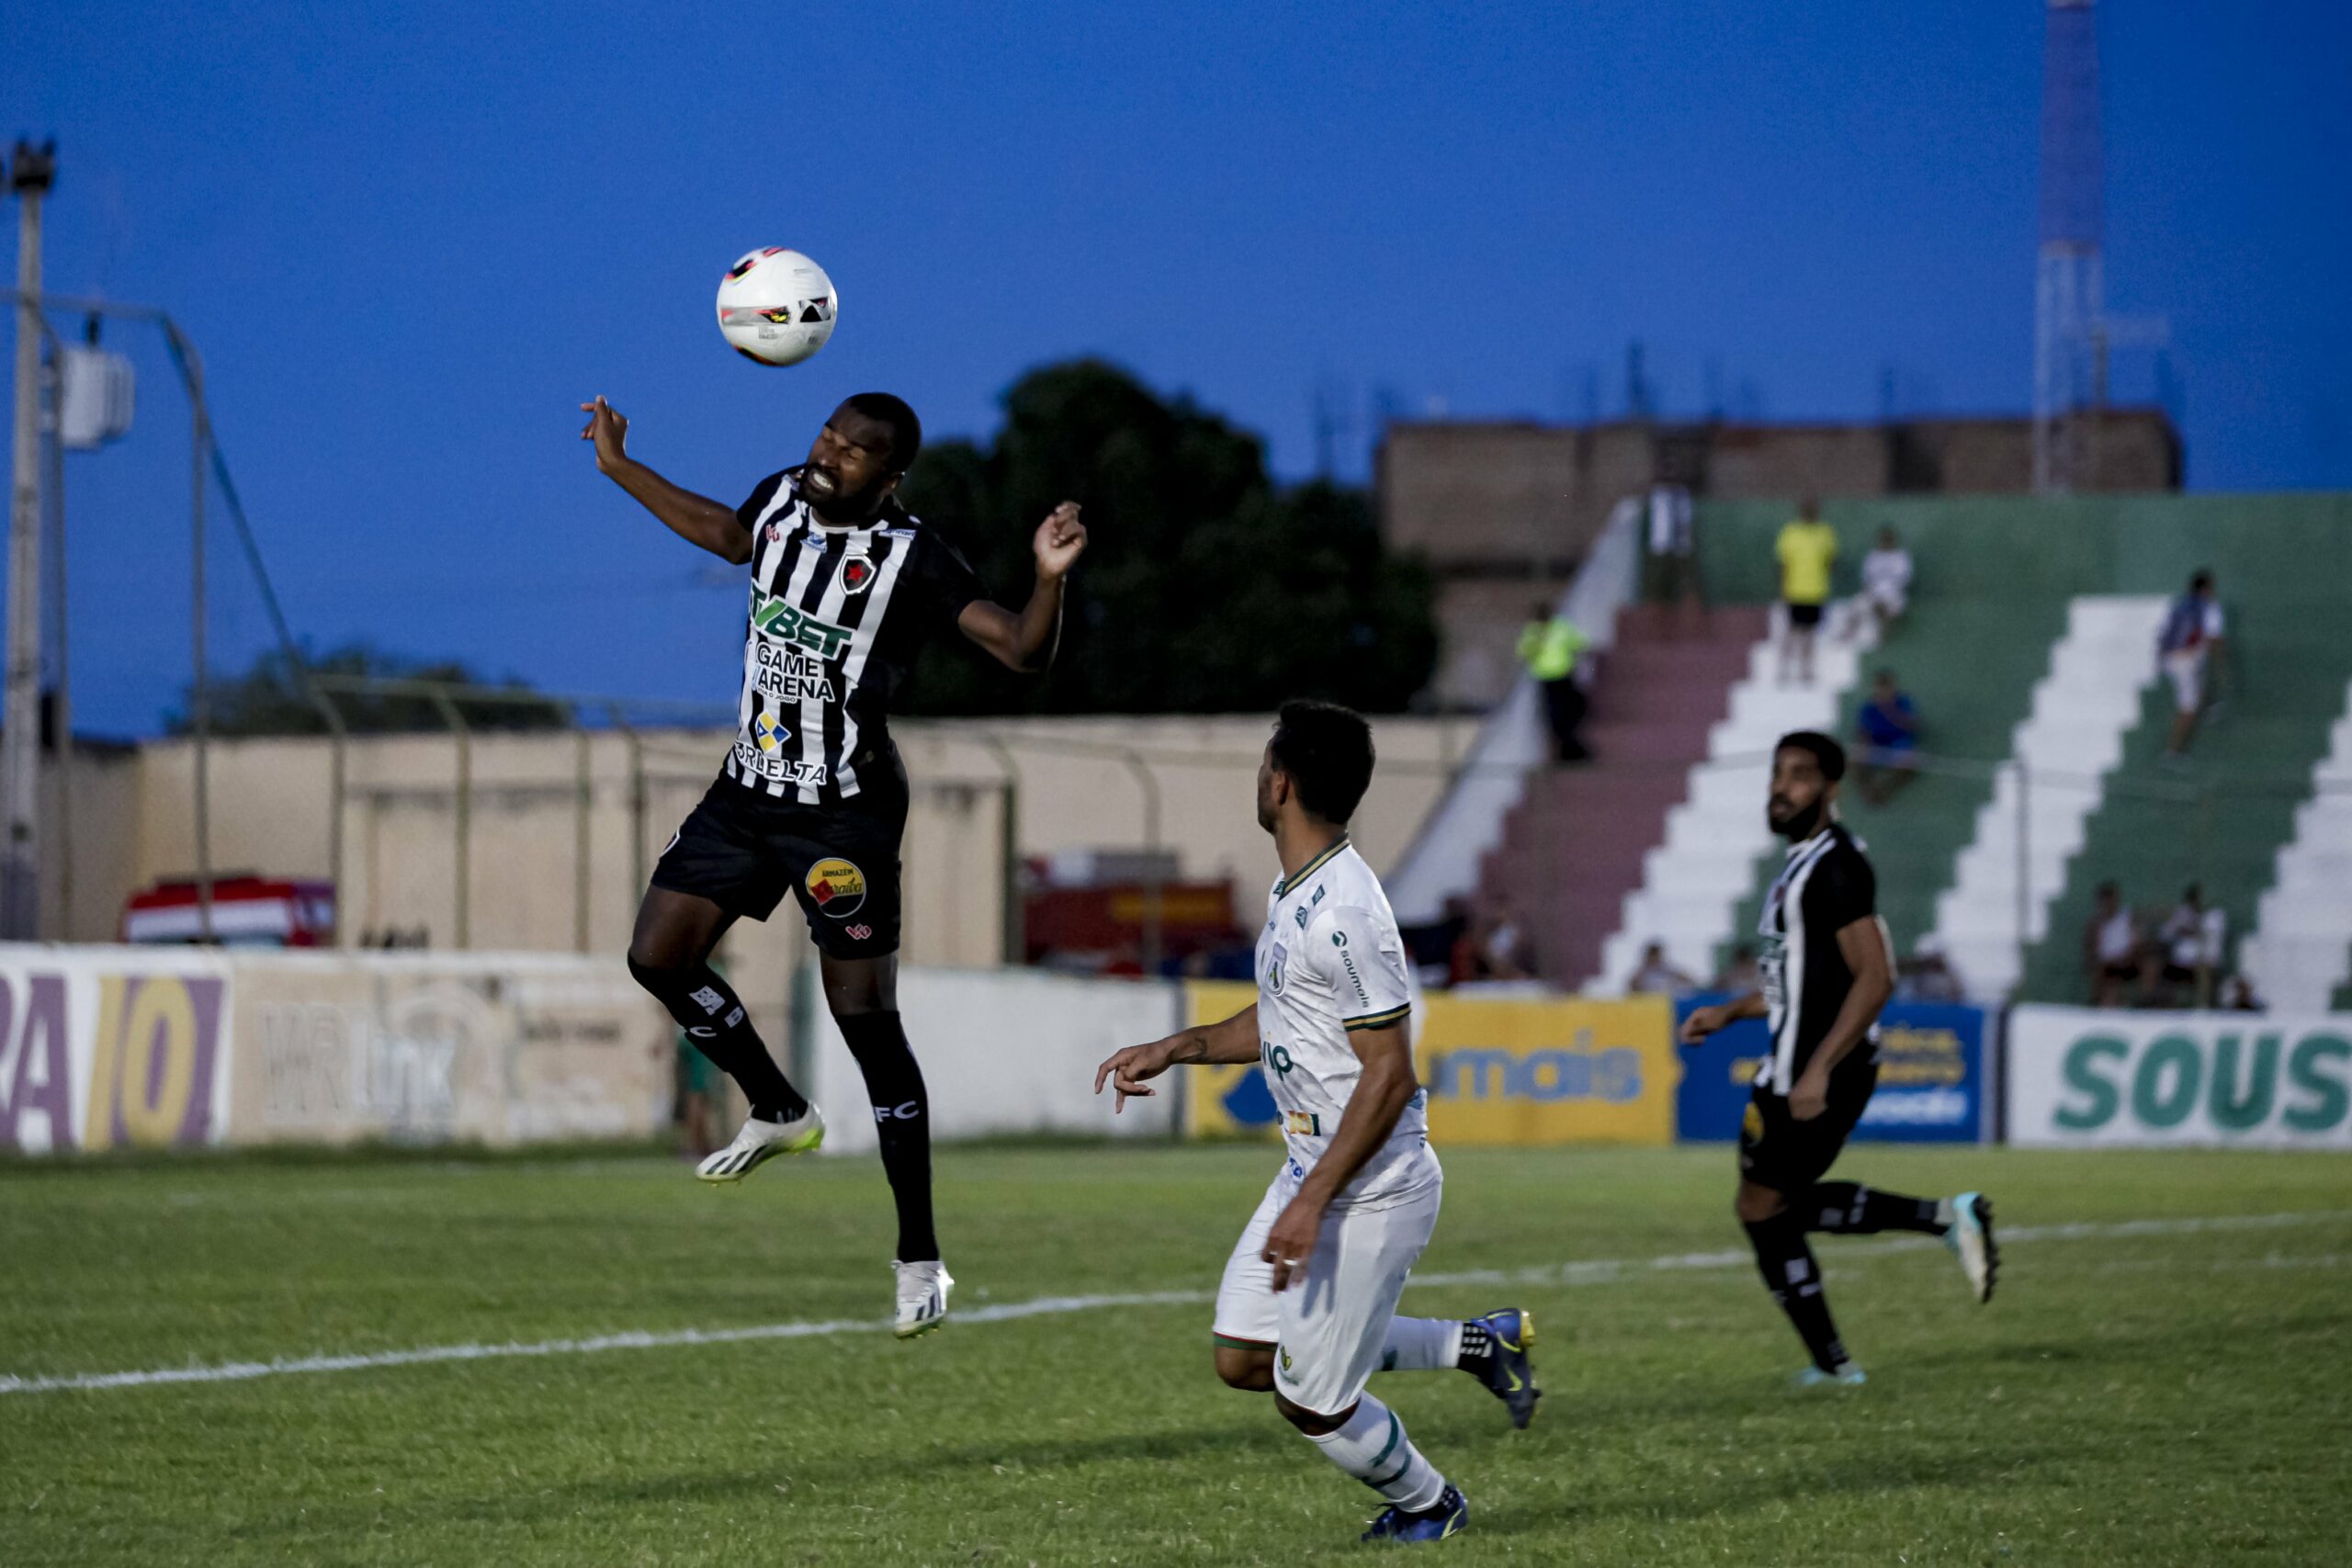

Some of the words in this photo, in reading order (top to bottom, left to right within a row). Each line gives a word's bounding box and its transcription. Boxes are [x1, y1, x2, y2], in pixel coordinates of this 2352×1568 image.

[751, 584, 854, 659] TVBET
[757, 644, 819, 678] GAME
[758, 668, 834, 699] ARENA
